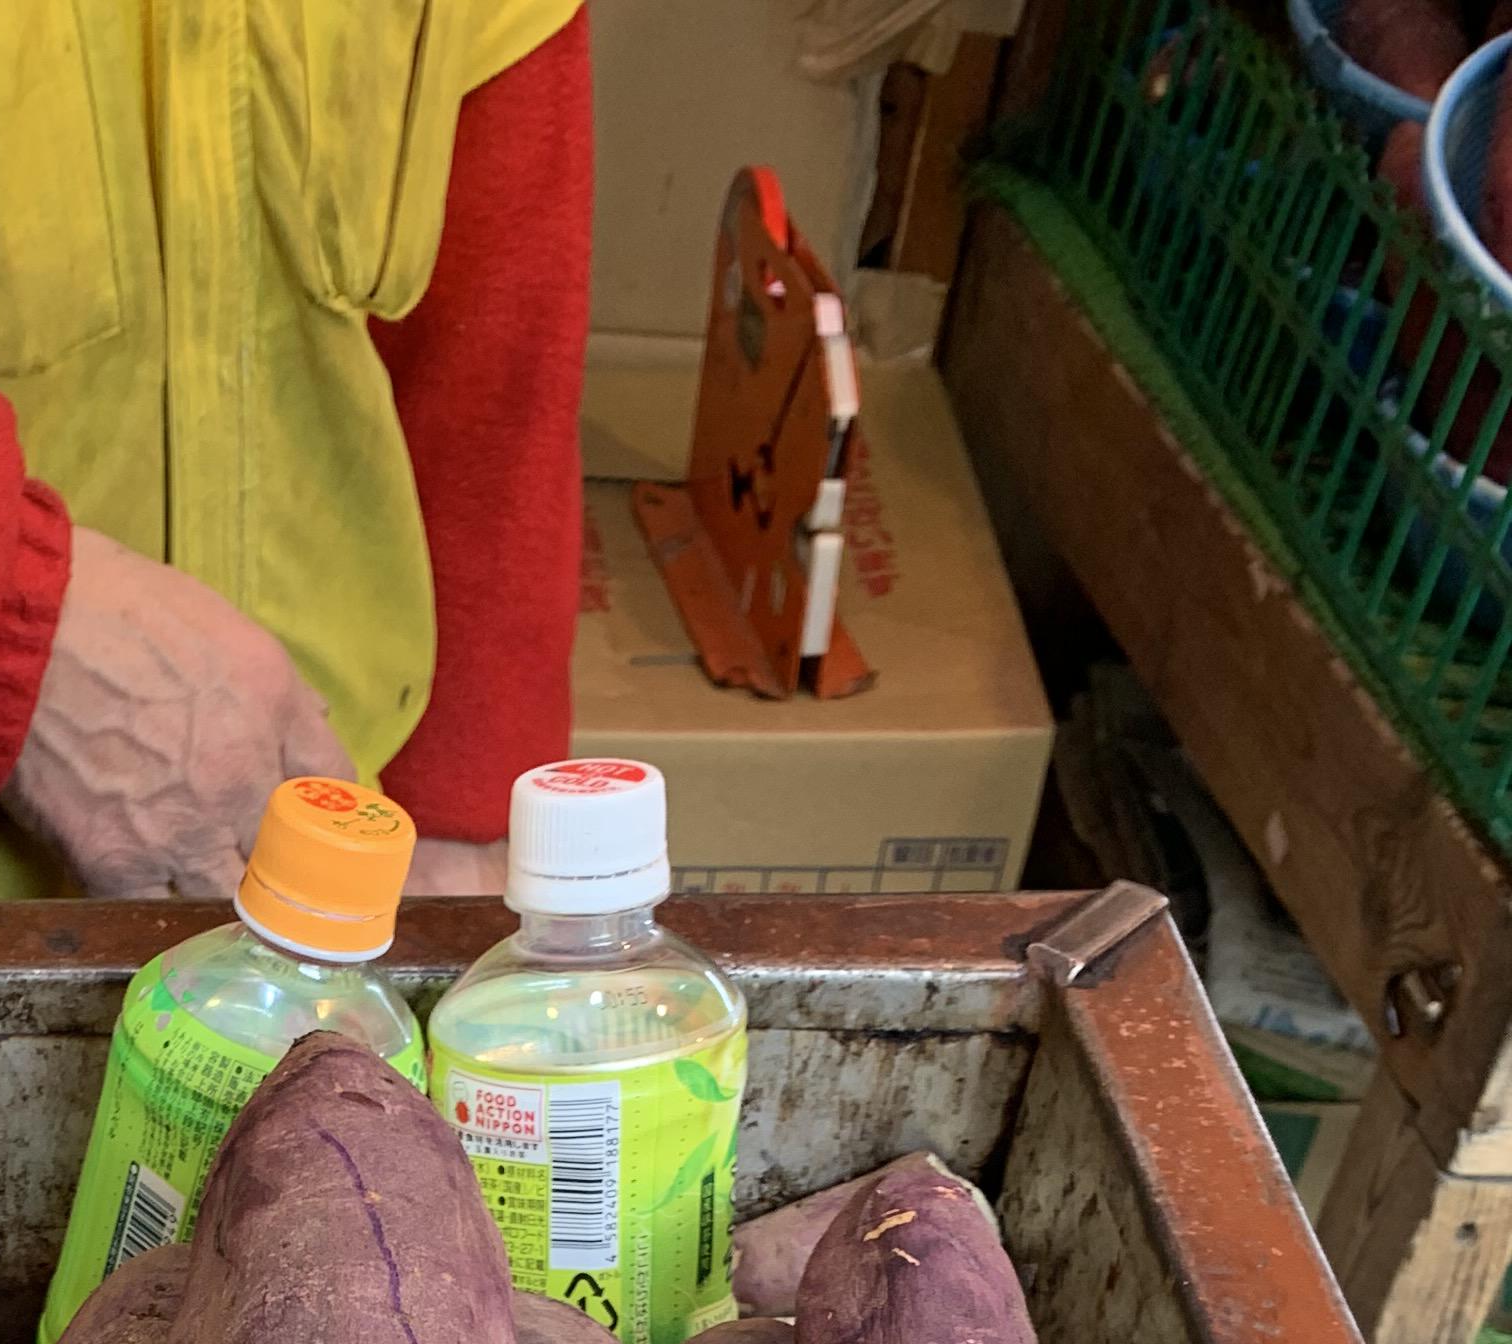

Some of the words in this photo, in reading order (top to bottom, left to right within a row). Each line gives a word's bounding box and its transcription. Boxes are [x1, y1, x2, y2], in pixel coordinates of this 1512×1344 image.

[475, 1089, 516, 1107] FOOD
[475, 1104, 535, 1122] ACTION
[475, 1116, 535, 1135] NIPPON
